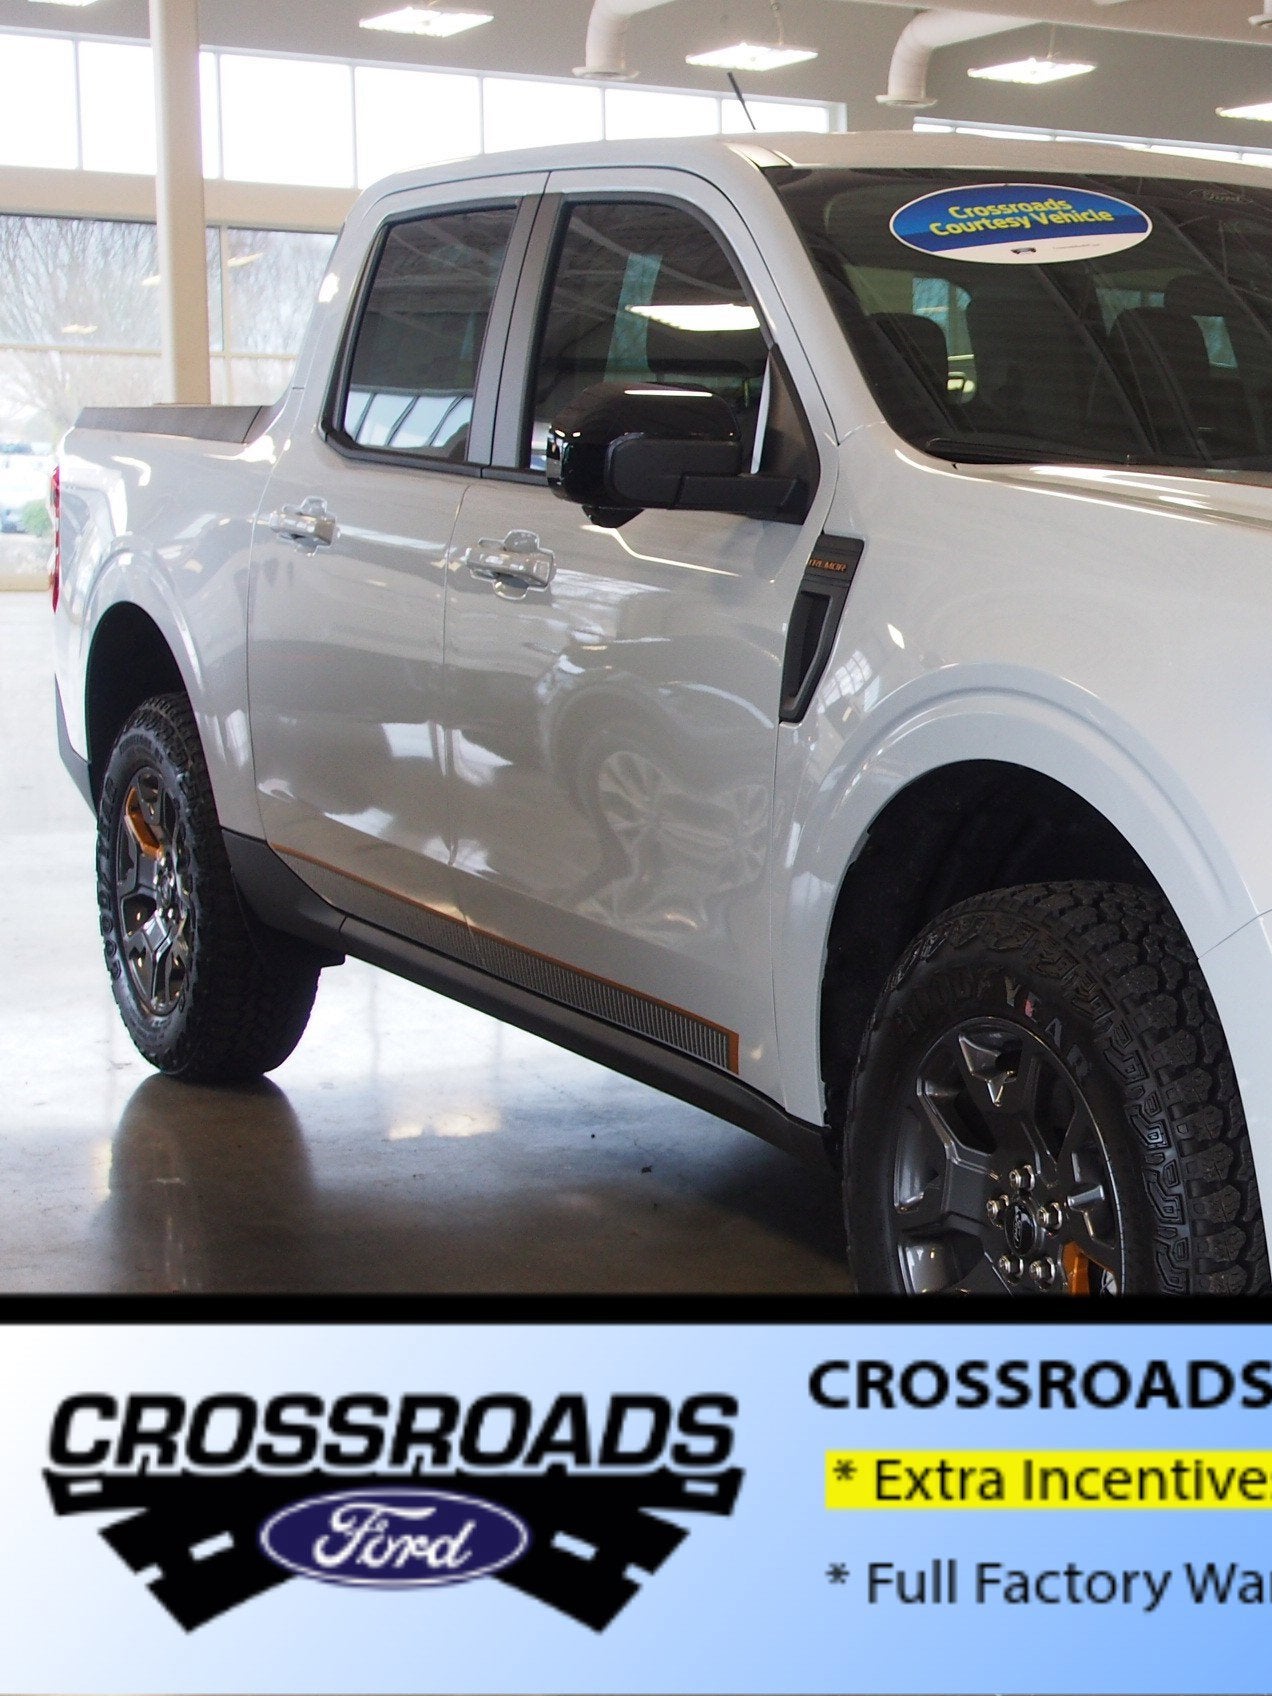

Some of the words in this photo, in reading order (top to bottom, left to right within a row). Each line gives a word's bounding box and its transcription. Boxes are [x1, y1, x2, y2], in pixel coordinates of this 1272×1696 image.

[948, 198, 1073, 220] Crossroads
[929, 214, 1032, 237] Courtesy
[1032, 208, 1116, 226] Vehicle
